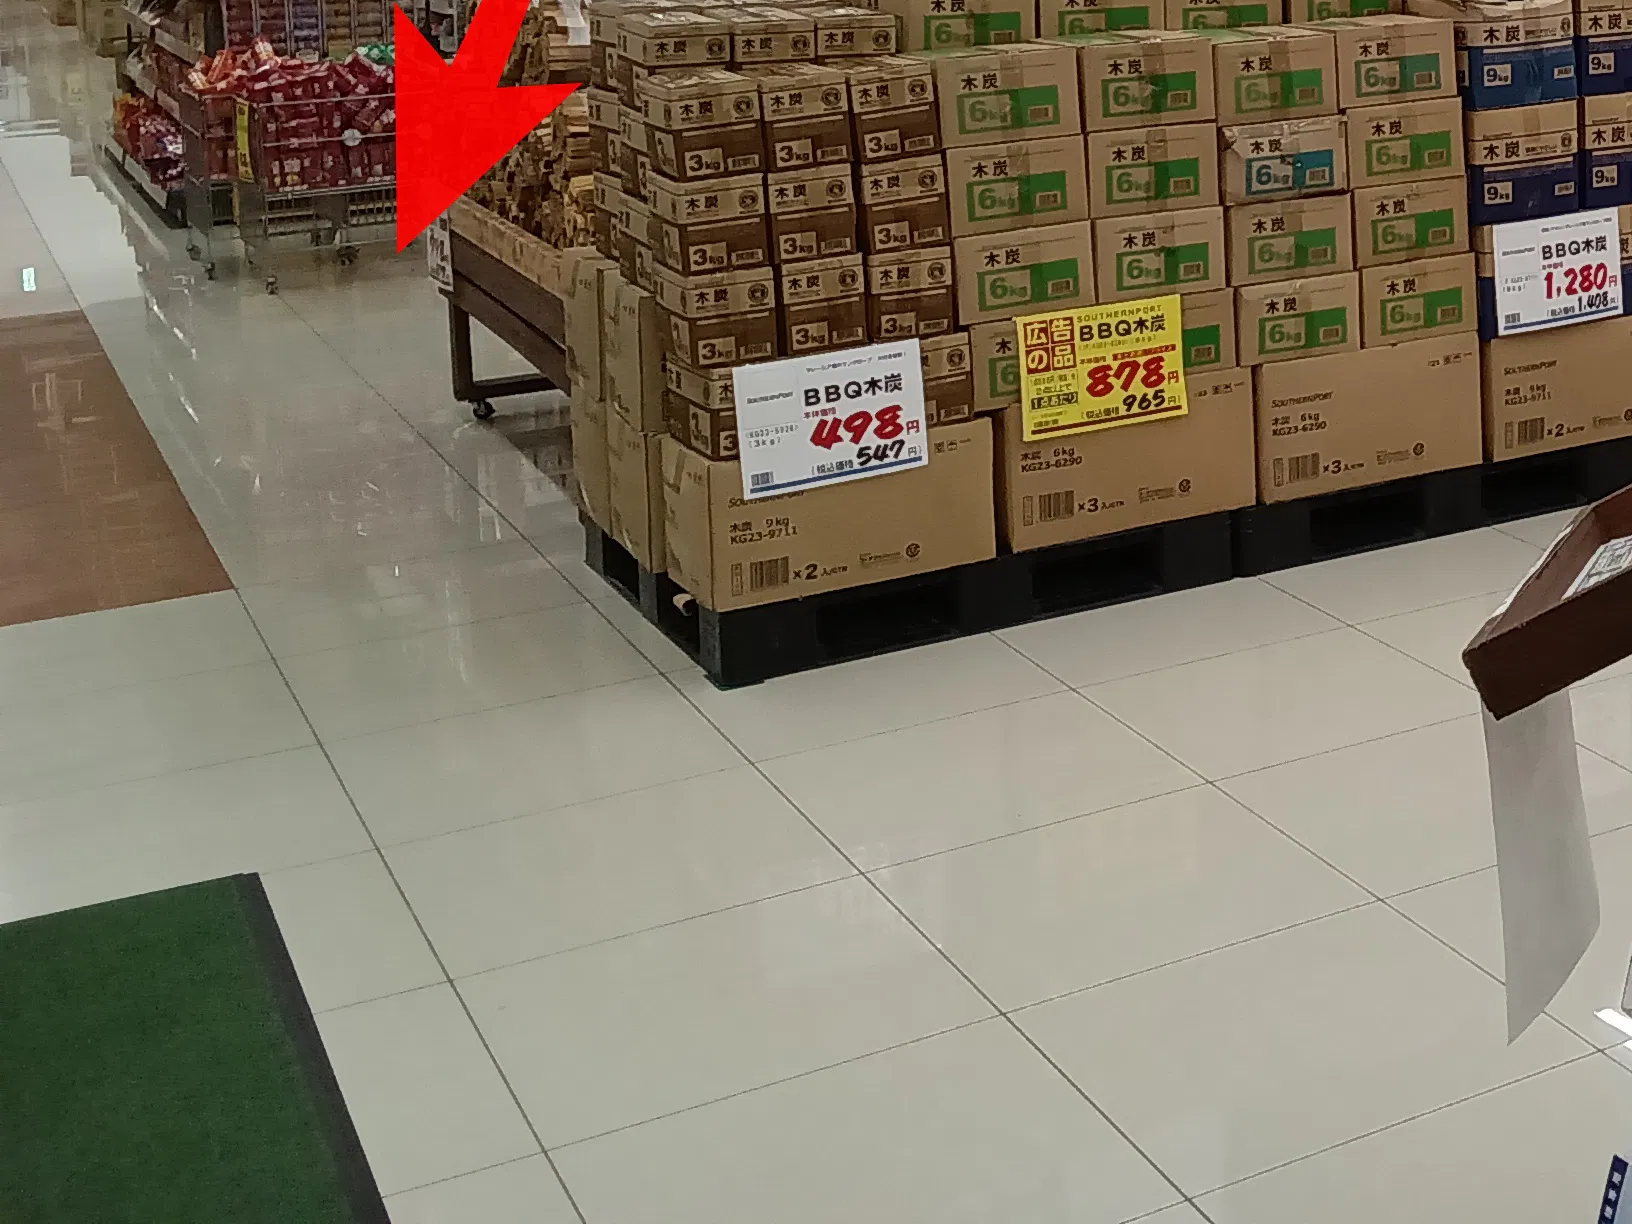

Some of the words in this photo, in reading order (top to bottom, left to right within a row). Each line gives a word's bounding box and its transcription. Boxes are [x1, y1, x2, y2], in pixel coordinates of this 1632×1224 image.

[824, 30, 855, 46] 木炭
[934, 21, 972, 43] 6kg
[654, 39, 687, 55] 木炭
[741, 37, 773, 52] 木炭
[1359, 41, 1390, 57] 木炭
[961, 73, 999, 90] 木炭
[1486, 67, 1509, 82] 9kg
[1592, 127, 1626, 145] 木炭
[1249, 138, 1283, 154] 木炭
[688, 153, 721, 173] 3kg
[1595, 169, 1615, 184] 9kg
[782, 236, 815, 255] 3kg
[1542, 235, 1608, 260] BBQ木炭
[1544, 262, 1608, 299] 1,280
[1076, 305, 1162, 323] SOUTHERNPORT
[1389, 300, 1424, 324] 6kg
[884, 317, 914, 335] 3kg
[1079, 313, 1166, 342] BBQ木炭
[1268, 322, 1303, 345] 6kg
[1085, 355, 1167, 397] 878
[1167, 370, 1179, 384] 円
[803, 372, 903, 407] BBQ木炭
[1122, 388, 1167, 412] 965
[809, 404, 905, 450] 498
[905, 419, 920, 435] 円
[856, 439, 906, 467] 547
[730, 526, 798, 545] KG23-9711
